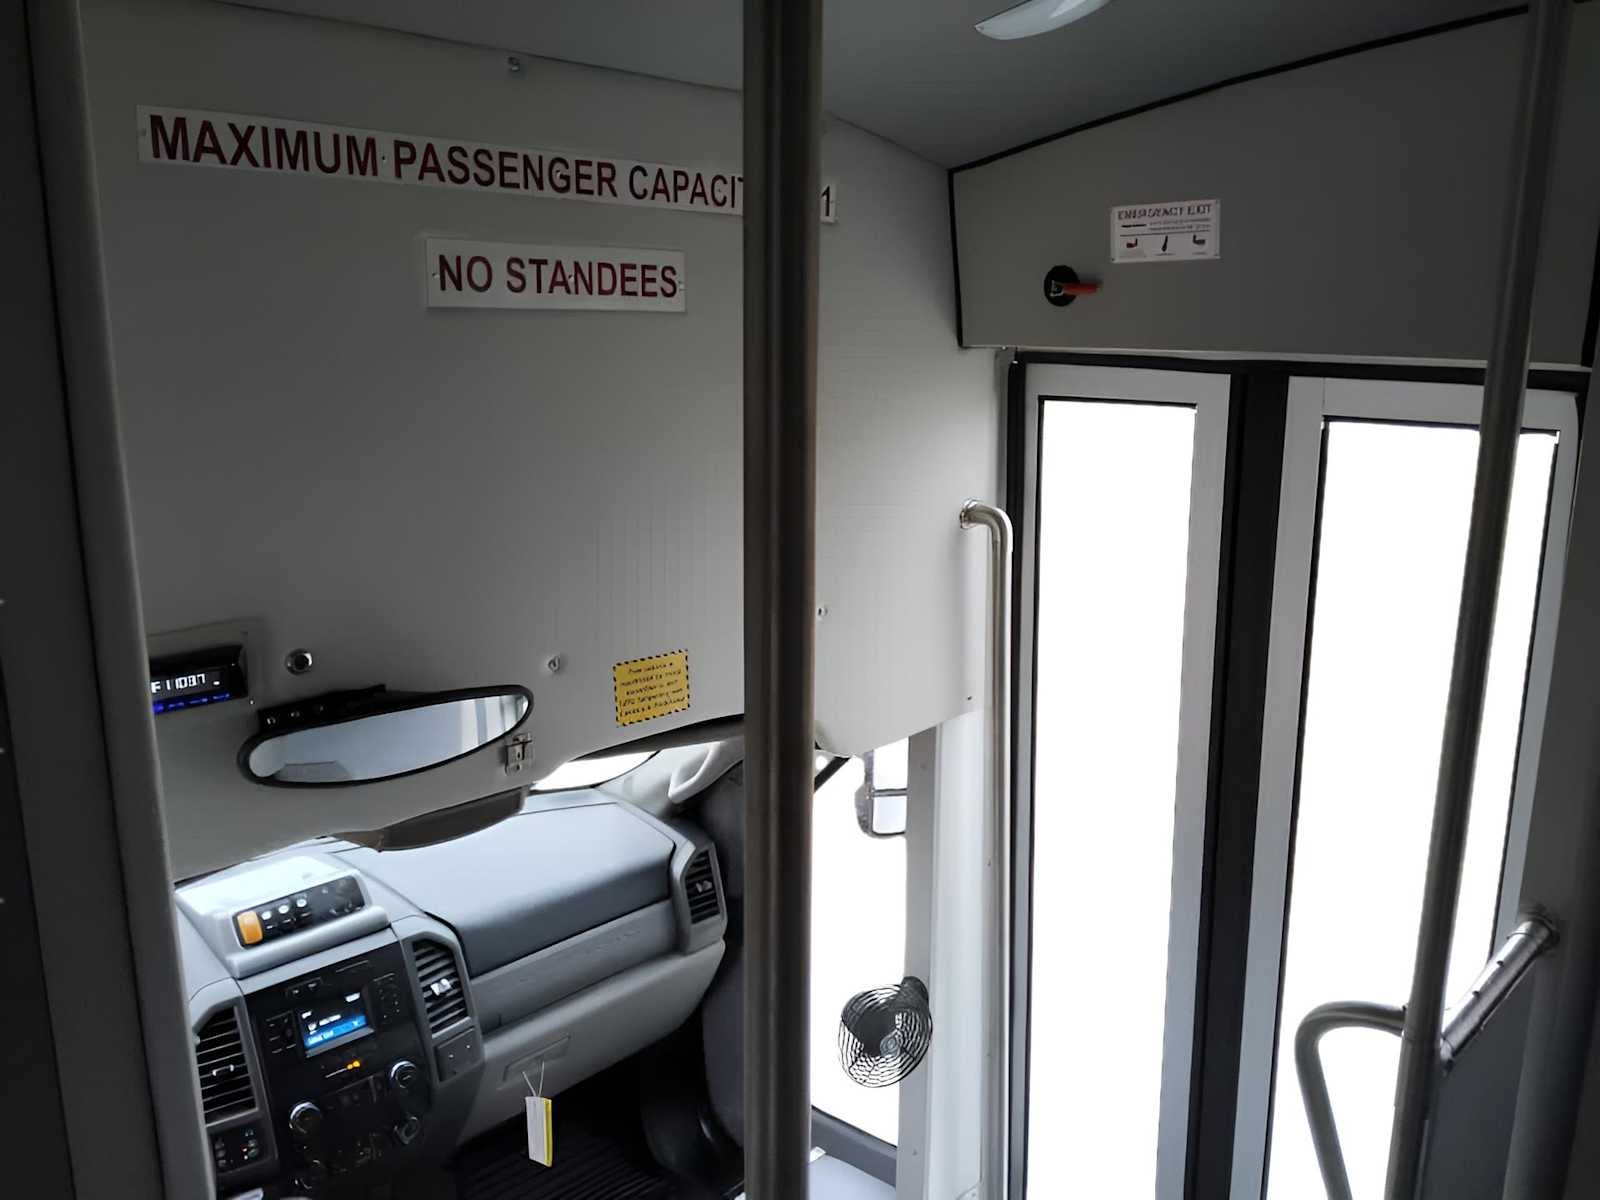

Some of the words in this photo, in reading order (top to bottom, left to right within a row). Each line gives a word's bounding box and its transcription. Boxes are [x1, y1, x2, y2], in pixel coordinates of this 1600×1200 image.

[149, 114, 379, 177] MAXIMUM
[393, 139, 618, 198] PASSENGER
[628, 164, 744, 209] CAPACI
[438, 254, 494, 293] NO
[505, 256, 679, 298] STANDEES
